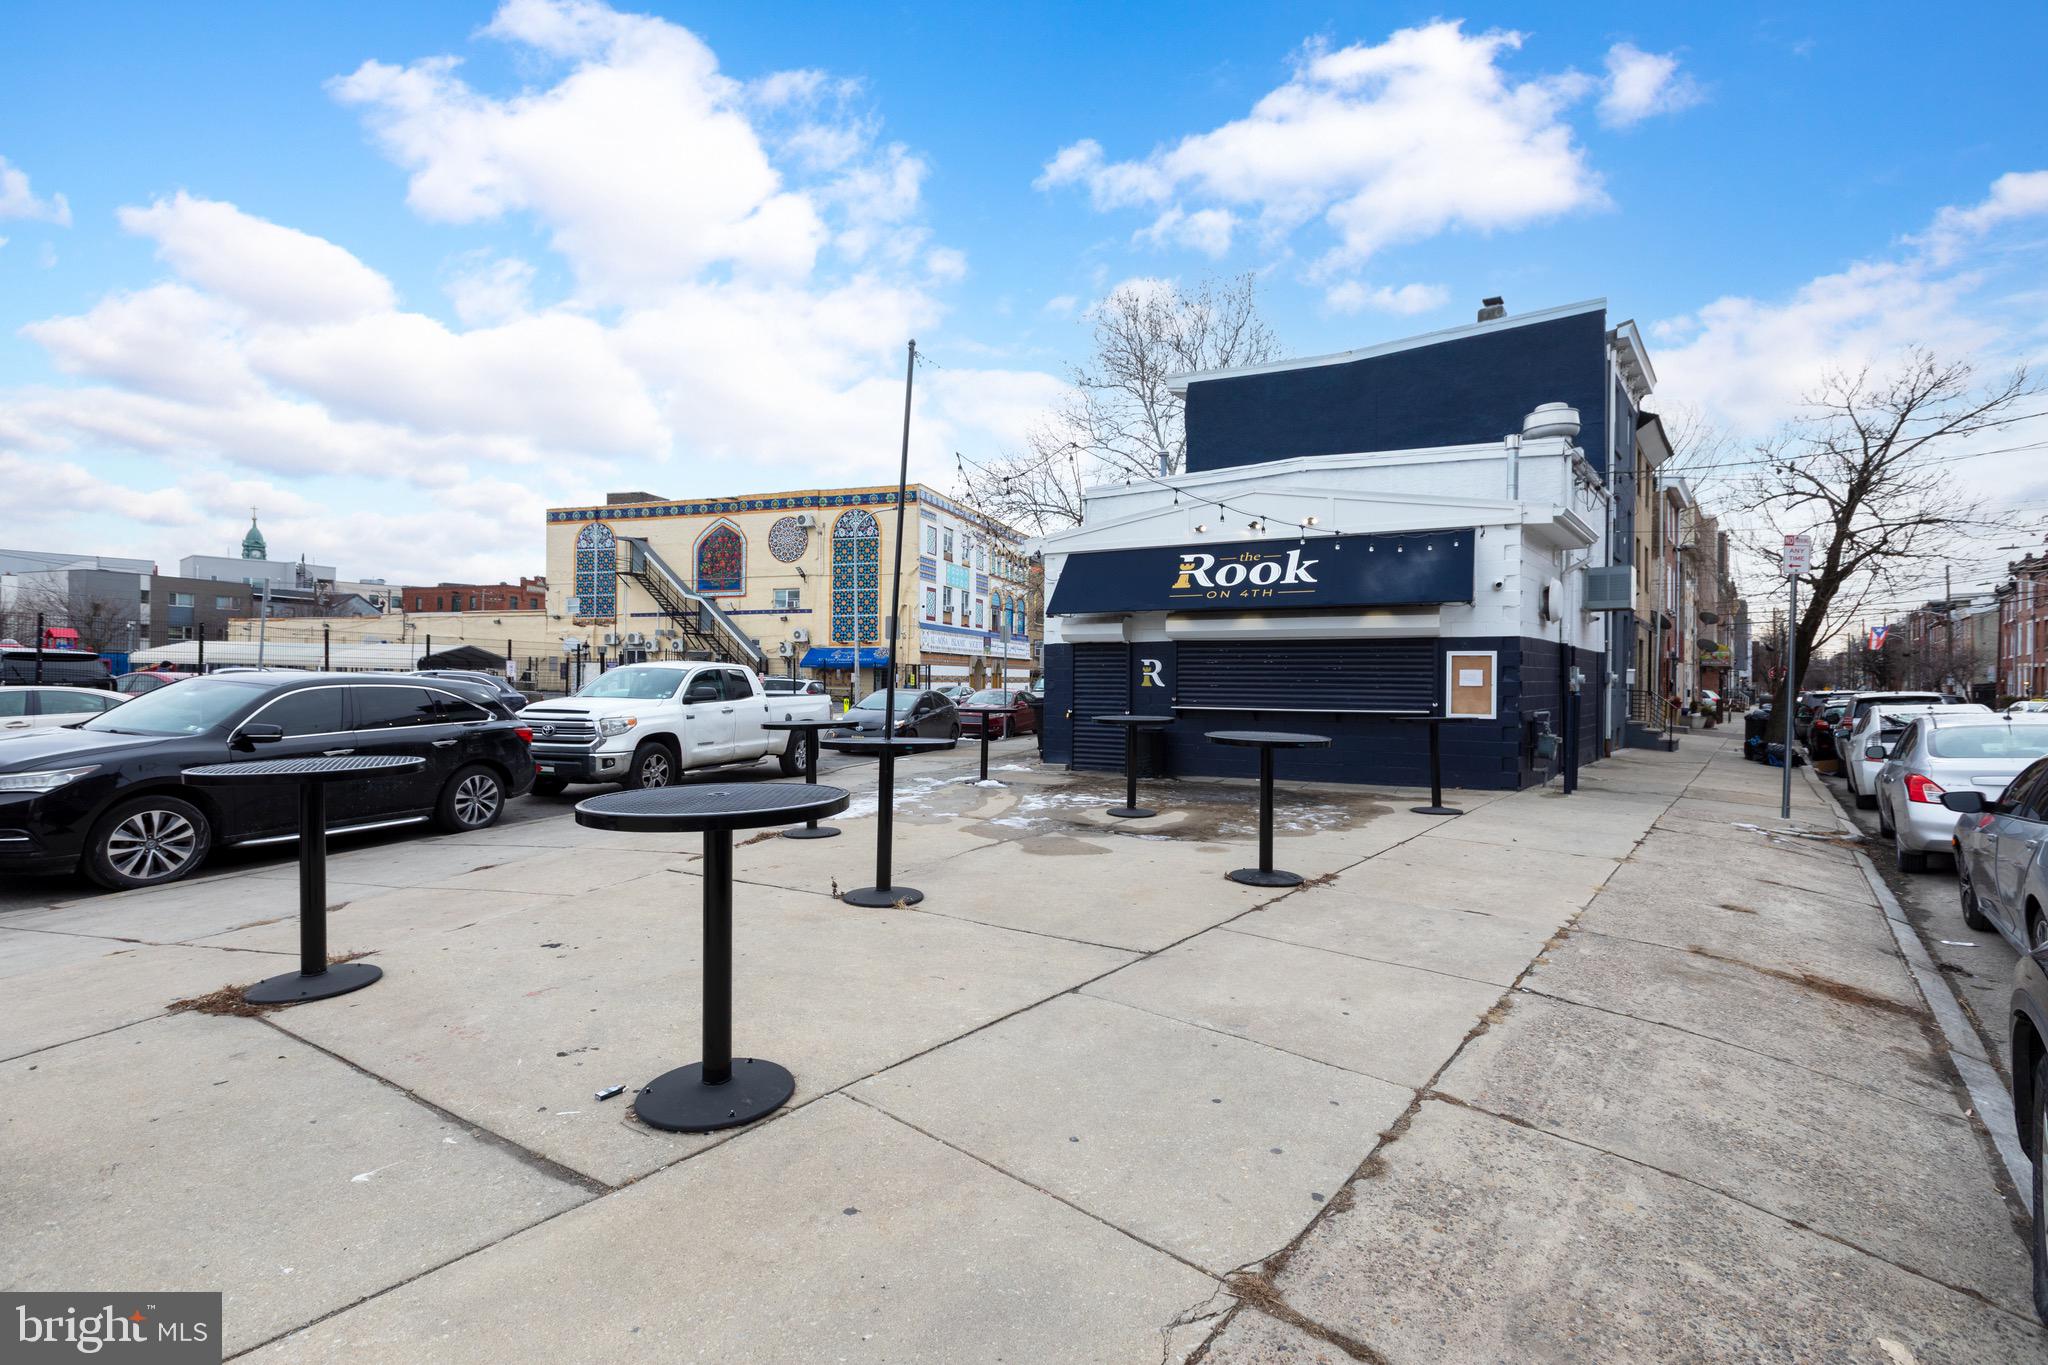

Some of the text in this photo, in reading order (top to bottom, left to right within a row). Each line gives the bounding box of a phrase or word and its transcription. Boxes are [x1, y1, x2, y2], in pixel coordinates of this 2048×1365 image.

[1785, 536, 1794, 545] NO
[1239, 552, 1262, 562] the
[1171, 549, 1319, 589] Rook
[1206, 588, 1274, 599] ON 4TH
[1141, 659, 1165, 687] R
